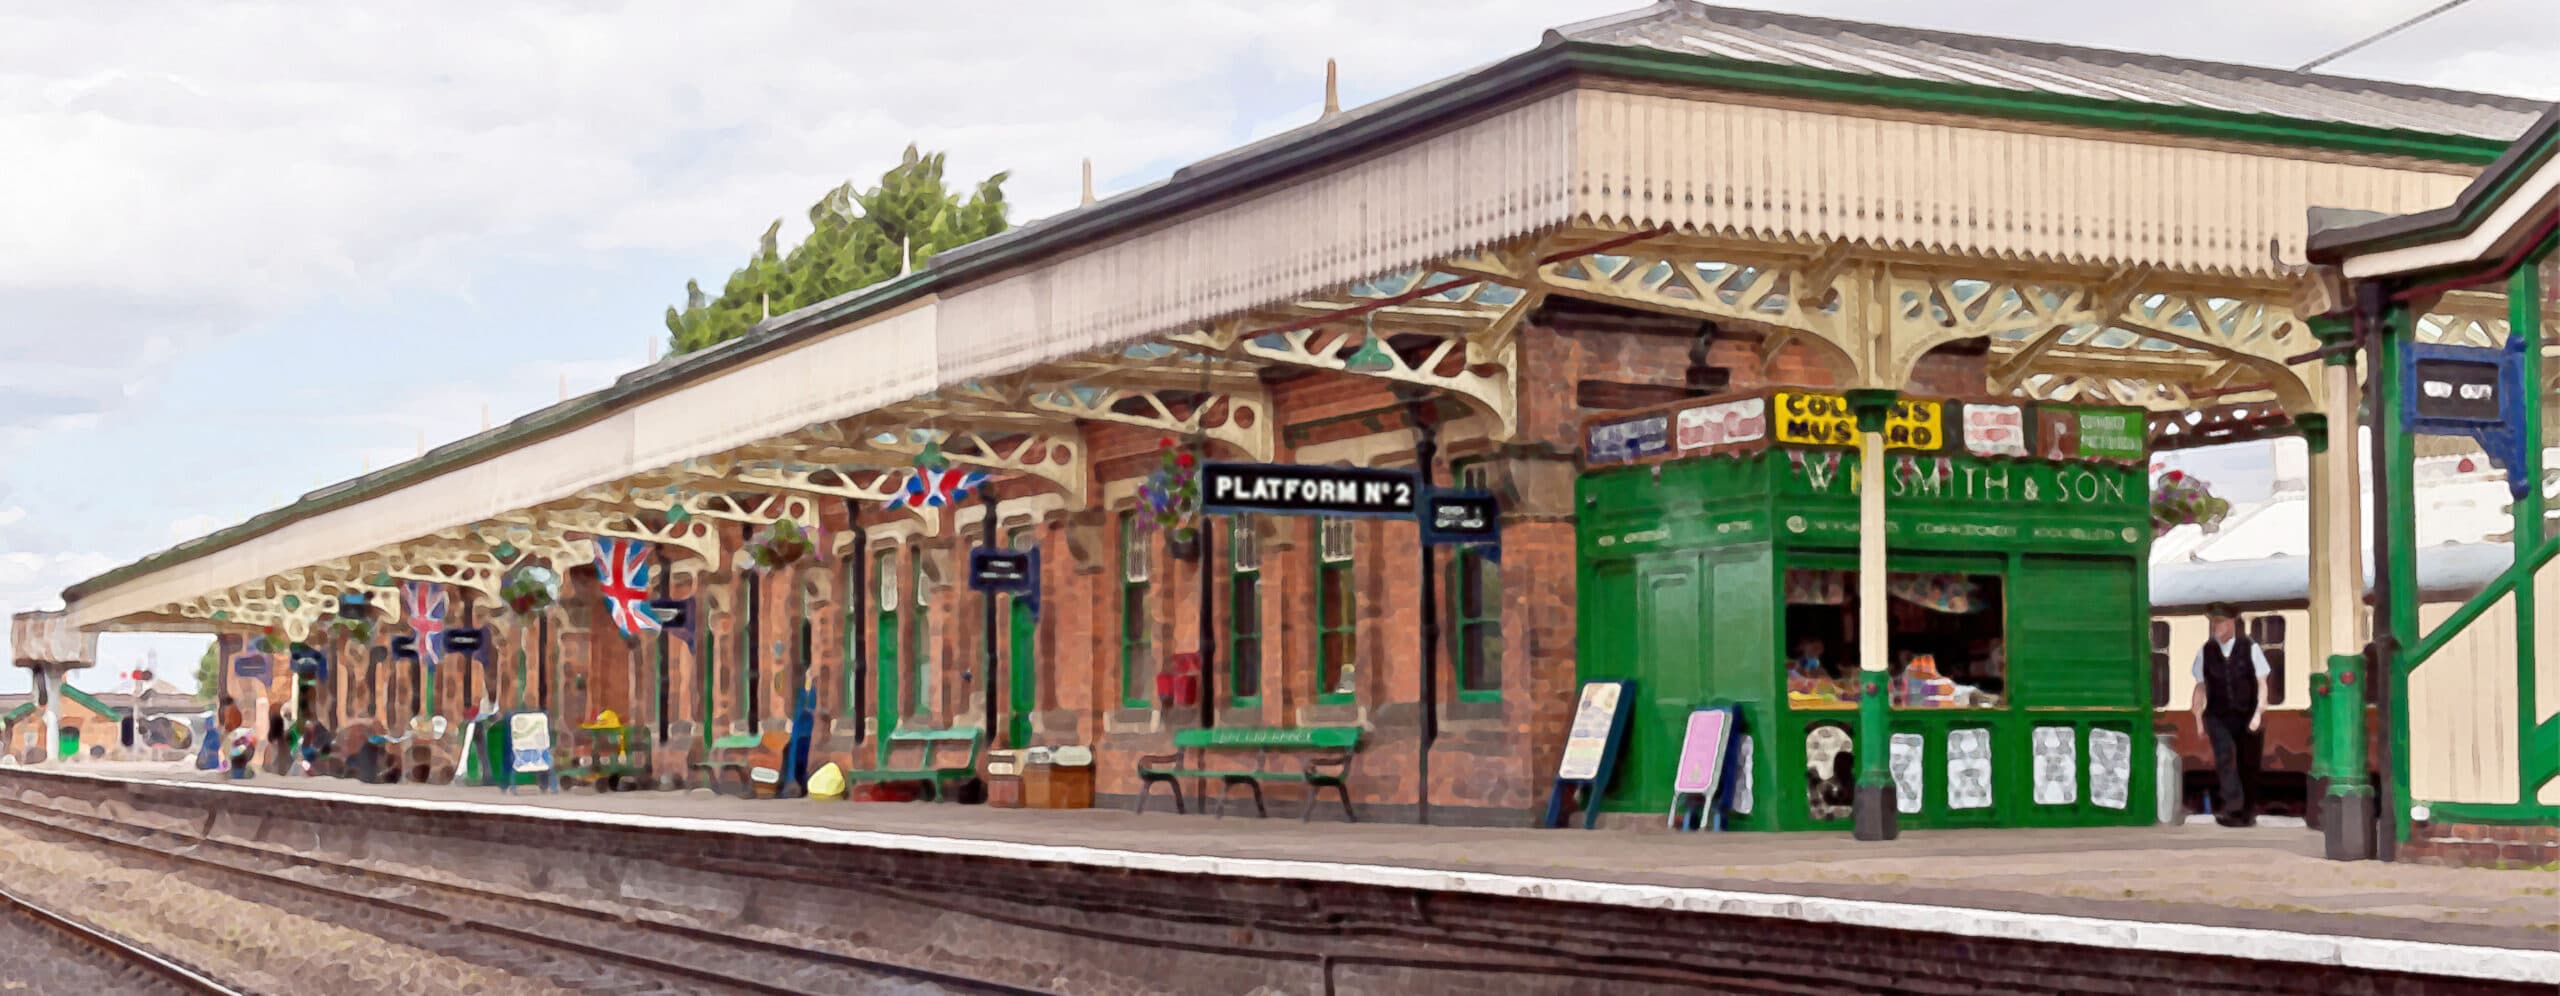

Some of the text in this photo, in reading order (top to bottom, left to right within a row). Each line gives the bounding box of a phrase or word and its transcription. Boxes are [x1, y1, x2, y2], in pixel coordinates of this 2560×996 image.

[1786, 392, 1930, 422] COLNS
[1788, 419, 1932, 446] MUSRD
[1215, 476, 1357, 504] PLATFORM
[1395, 484, 1411, 505] 2
[1891, 458, 2010, 501] SMITH
[2023, 475, 2041, 501] &
[2056, 469, 2126, 503] SON
